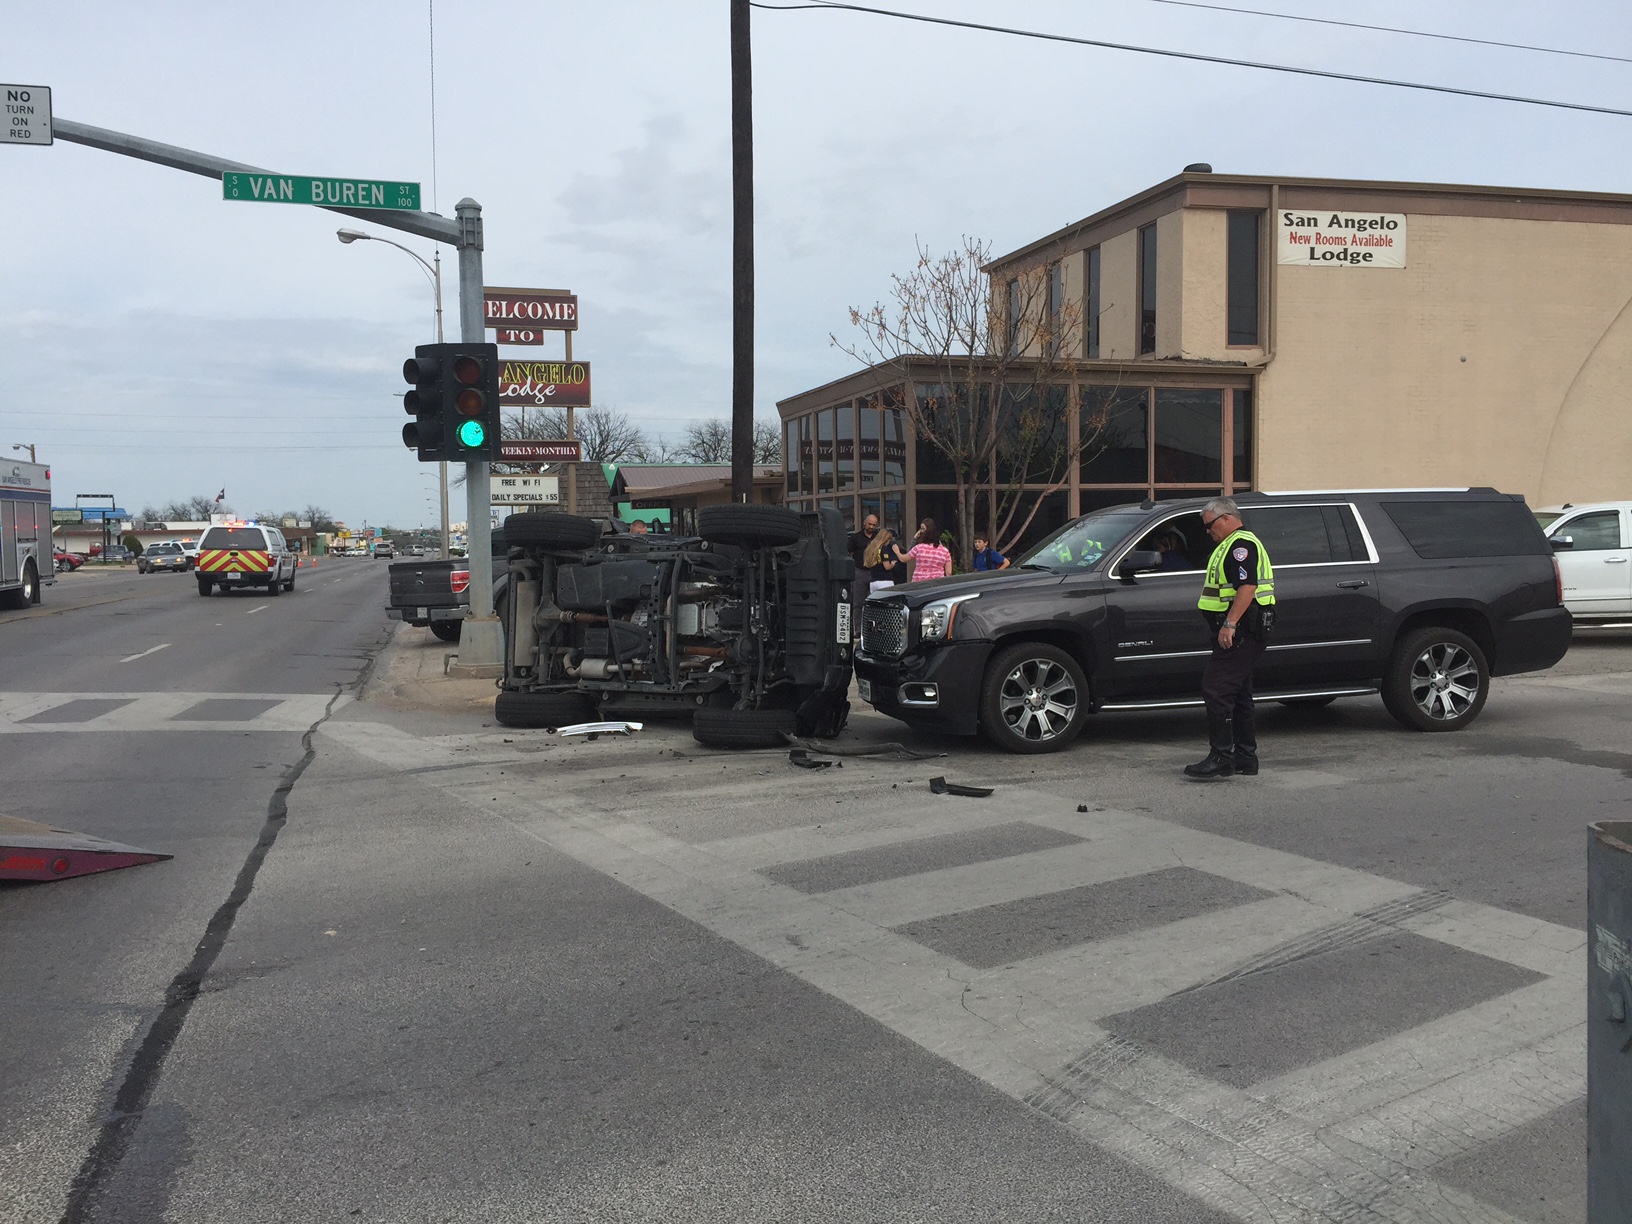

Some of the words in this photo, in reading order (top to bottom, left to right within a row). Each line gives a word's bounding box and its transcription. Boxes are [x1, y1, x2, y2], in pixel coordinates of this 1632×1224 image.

[7, 90, 31, 102] NO
[5, 104, 34, 114] TURN
[12, 117, 28, 126] ON
[10, 129, 31, 139] RED
[232, 176, 238, 184] S
[249, 177, 293, 200] VAN
[311, 181, 384, 205] BUREN
[399, 186, 410, 195] ST
[397, 198, 412, 207] 100
[1283, 212, 1318, 228] San
[1327, 214, 1398, 232] Angelo
[1289, 231, 1311, 245] New
[1315, 232, 1347, 246] Rooms
[1351, 234, 1393, 247] Available
[1309, 247, 1374, 264] Lodge
[483, 300, 575, 320] ELCOME
[505, 330, 535, 342] TO
[501, 362, 585, 385] ANGELO
[1117, 640, 1154, 648] DENALI
